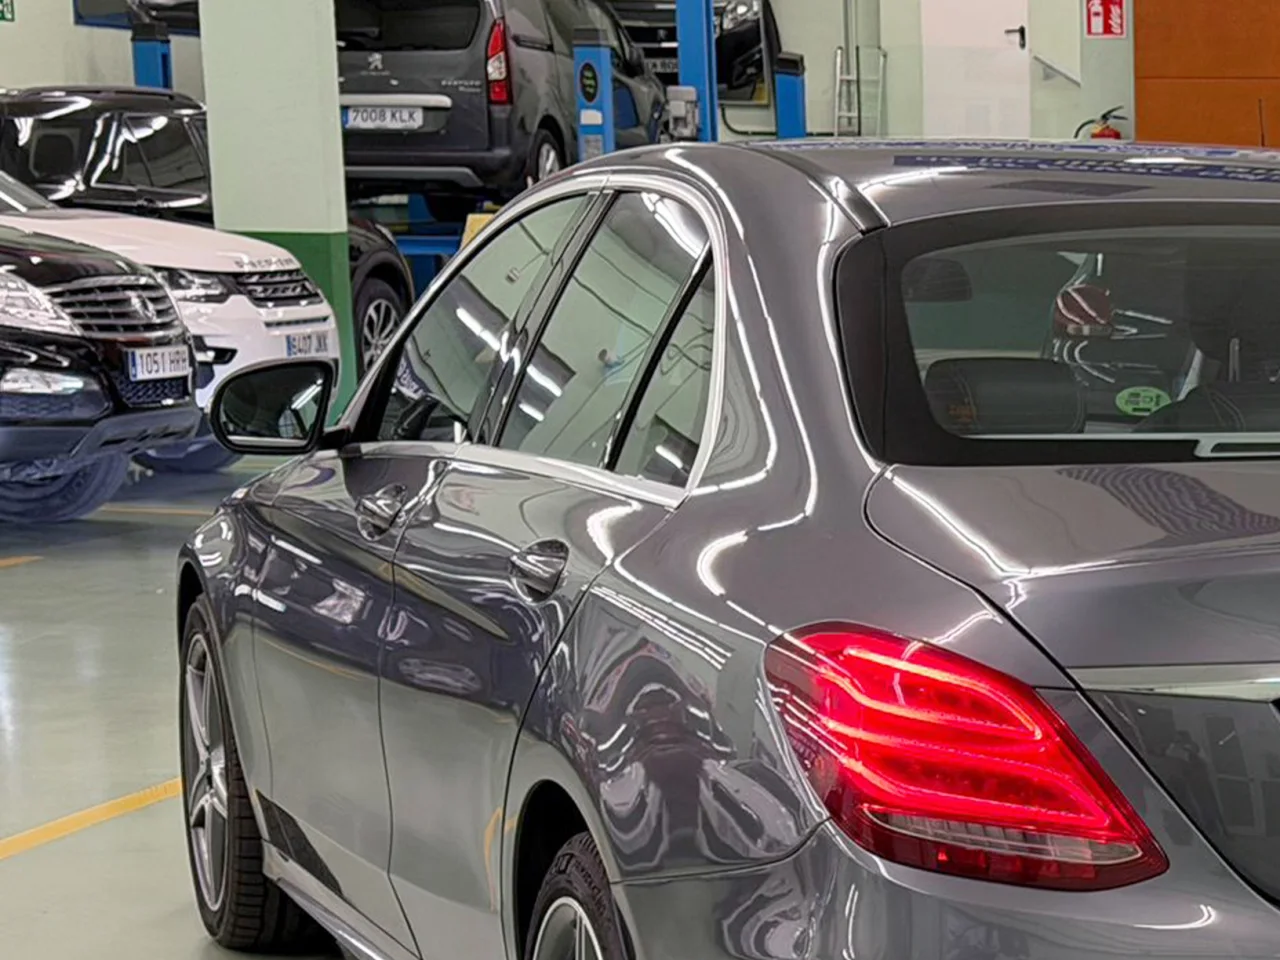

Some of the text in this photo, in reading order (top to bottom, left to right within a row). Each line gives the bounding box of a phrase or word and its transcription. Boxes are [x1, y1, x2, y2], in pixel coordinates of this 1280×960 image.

[353, 108, 416, 123] 7008 KLK
[140, 352, 166, 376] 1051
